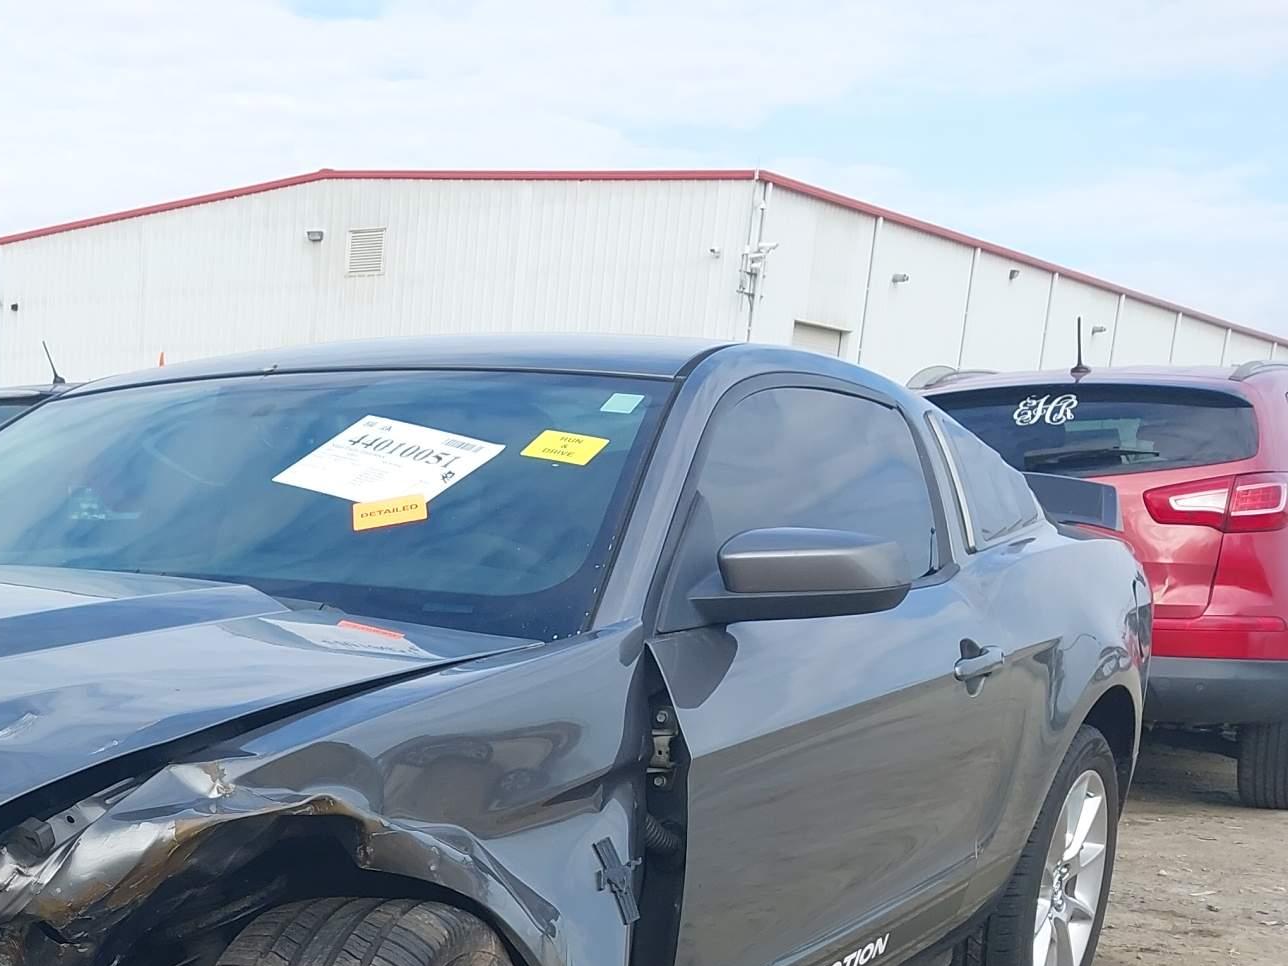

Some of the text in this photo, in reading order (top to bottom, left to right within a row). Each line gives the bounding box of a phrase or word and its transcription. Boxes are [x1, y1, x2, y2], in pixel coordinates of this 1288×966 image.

[559, 436, 584, 445] RUN
[348, 434, 461, 468] 44010051
[541, 447, 576, 458] DRIVE
[360, 503, 419, 519] DETAILED
